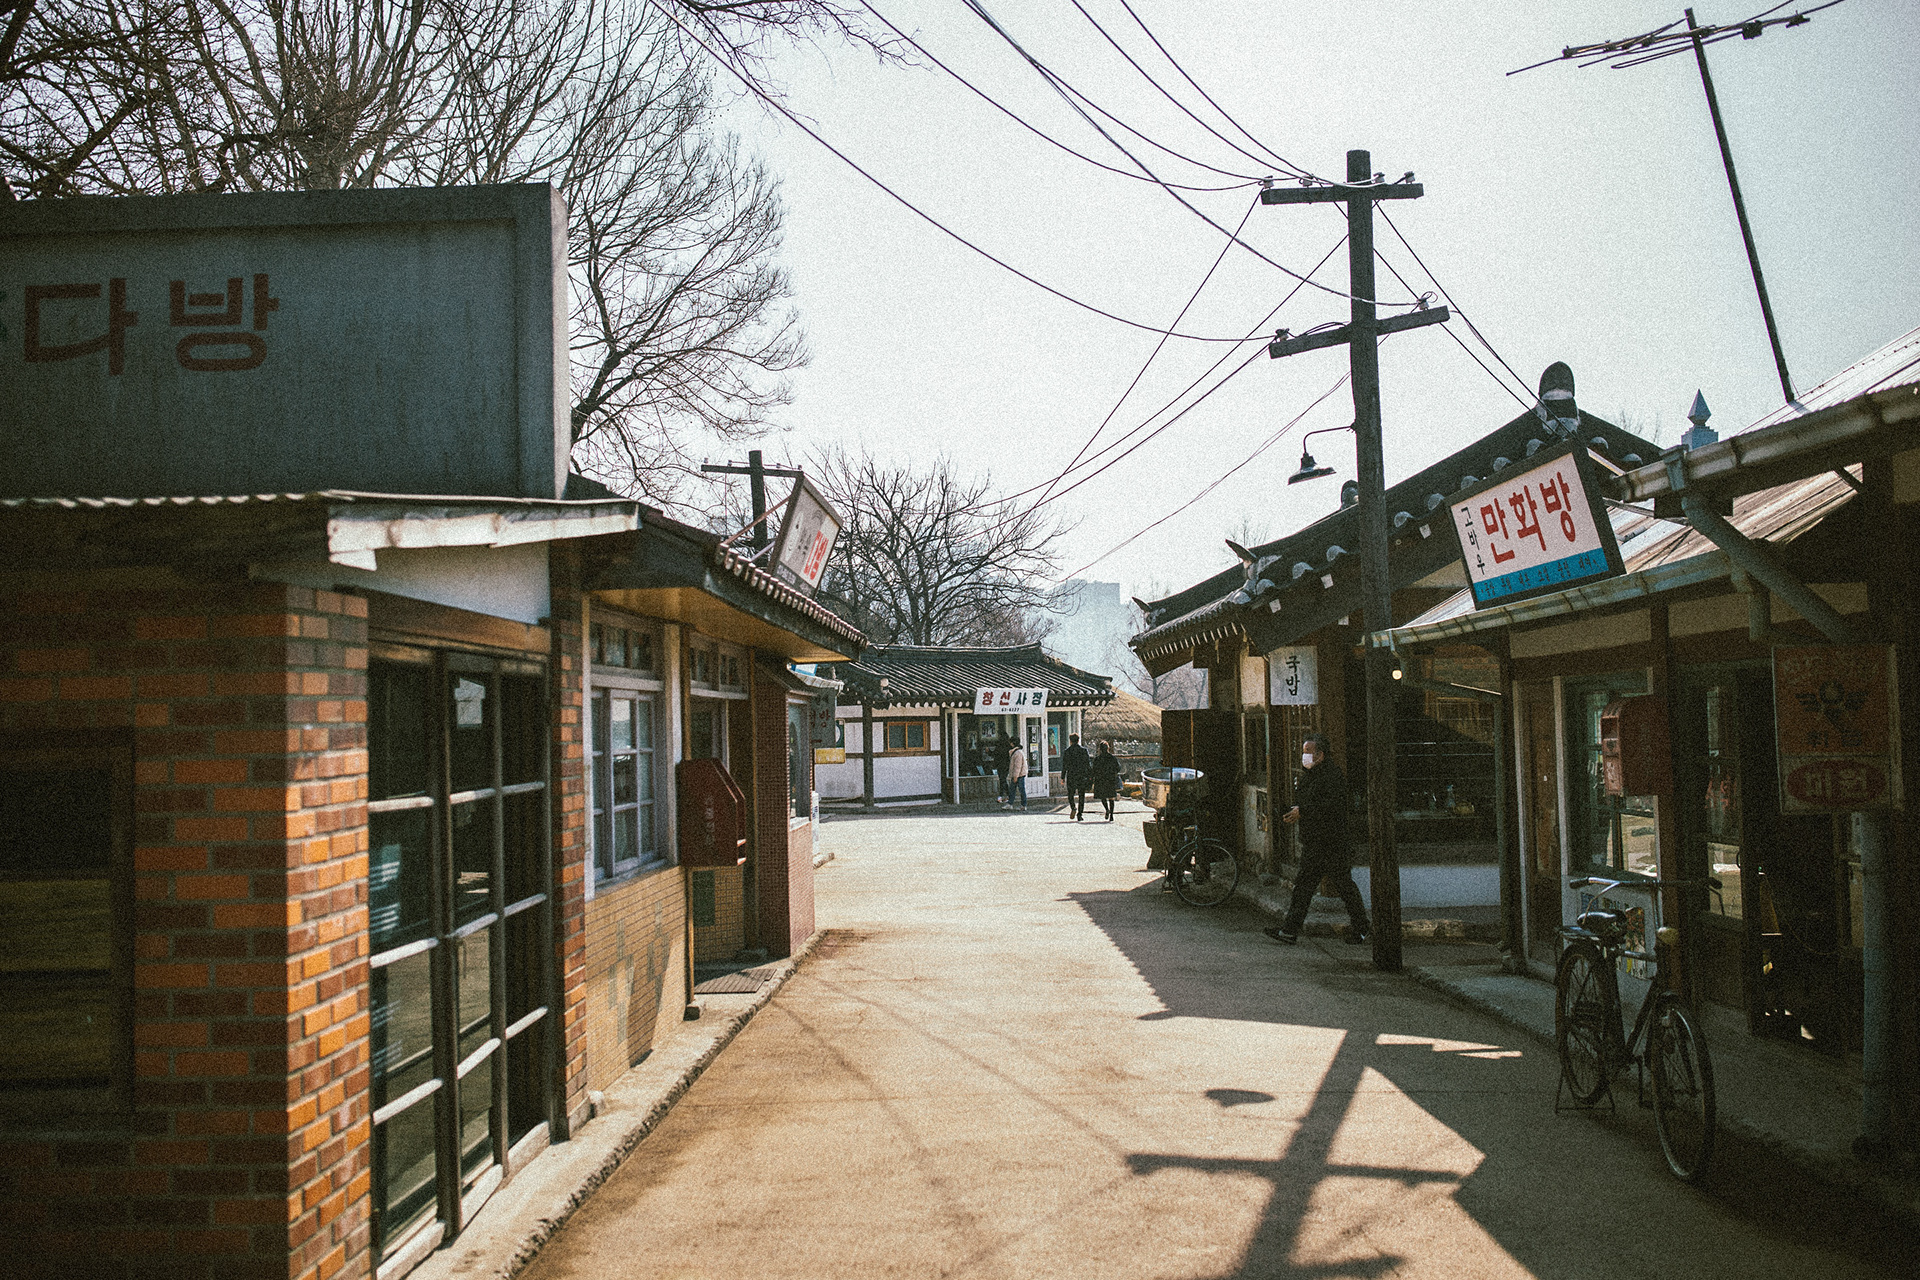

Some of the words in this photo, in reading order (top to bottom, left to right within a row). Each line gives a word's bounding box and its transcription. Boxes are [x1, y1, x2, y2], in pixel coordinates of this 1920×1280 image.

[24, 273, 279, 375] 다방
[1461, 506, 1486, 576] 고바우
[1480, 471, 1576, 564] 만화방
[1286, 656, 1300, 696] 국밥
